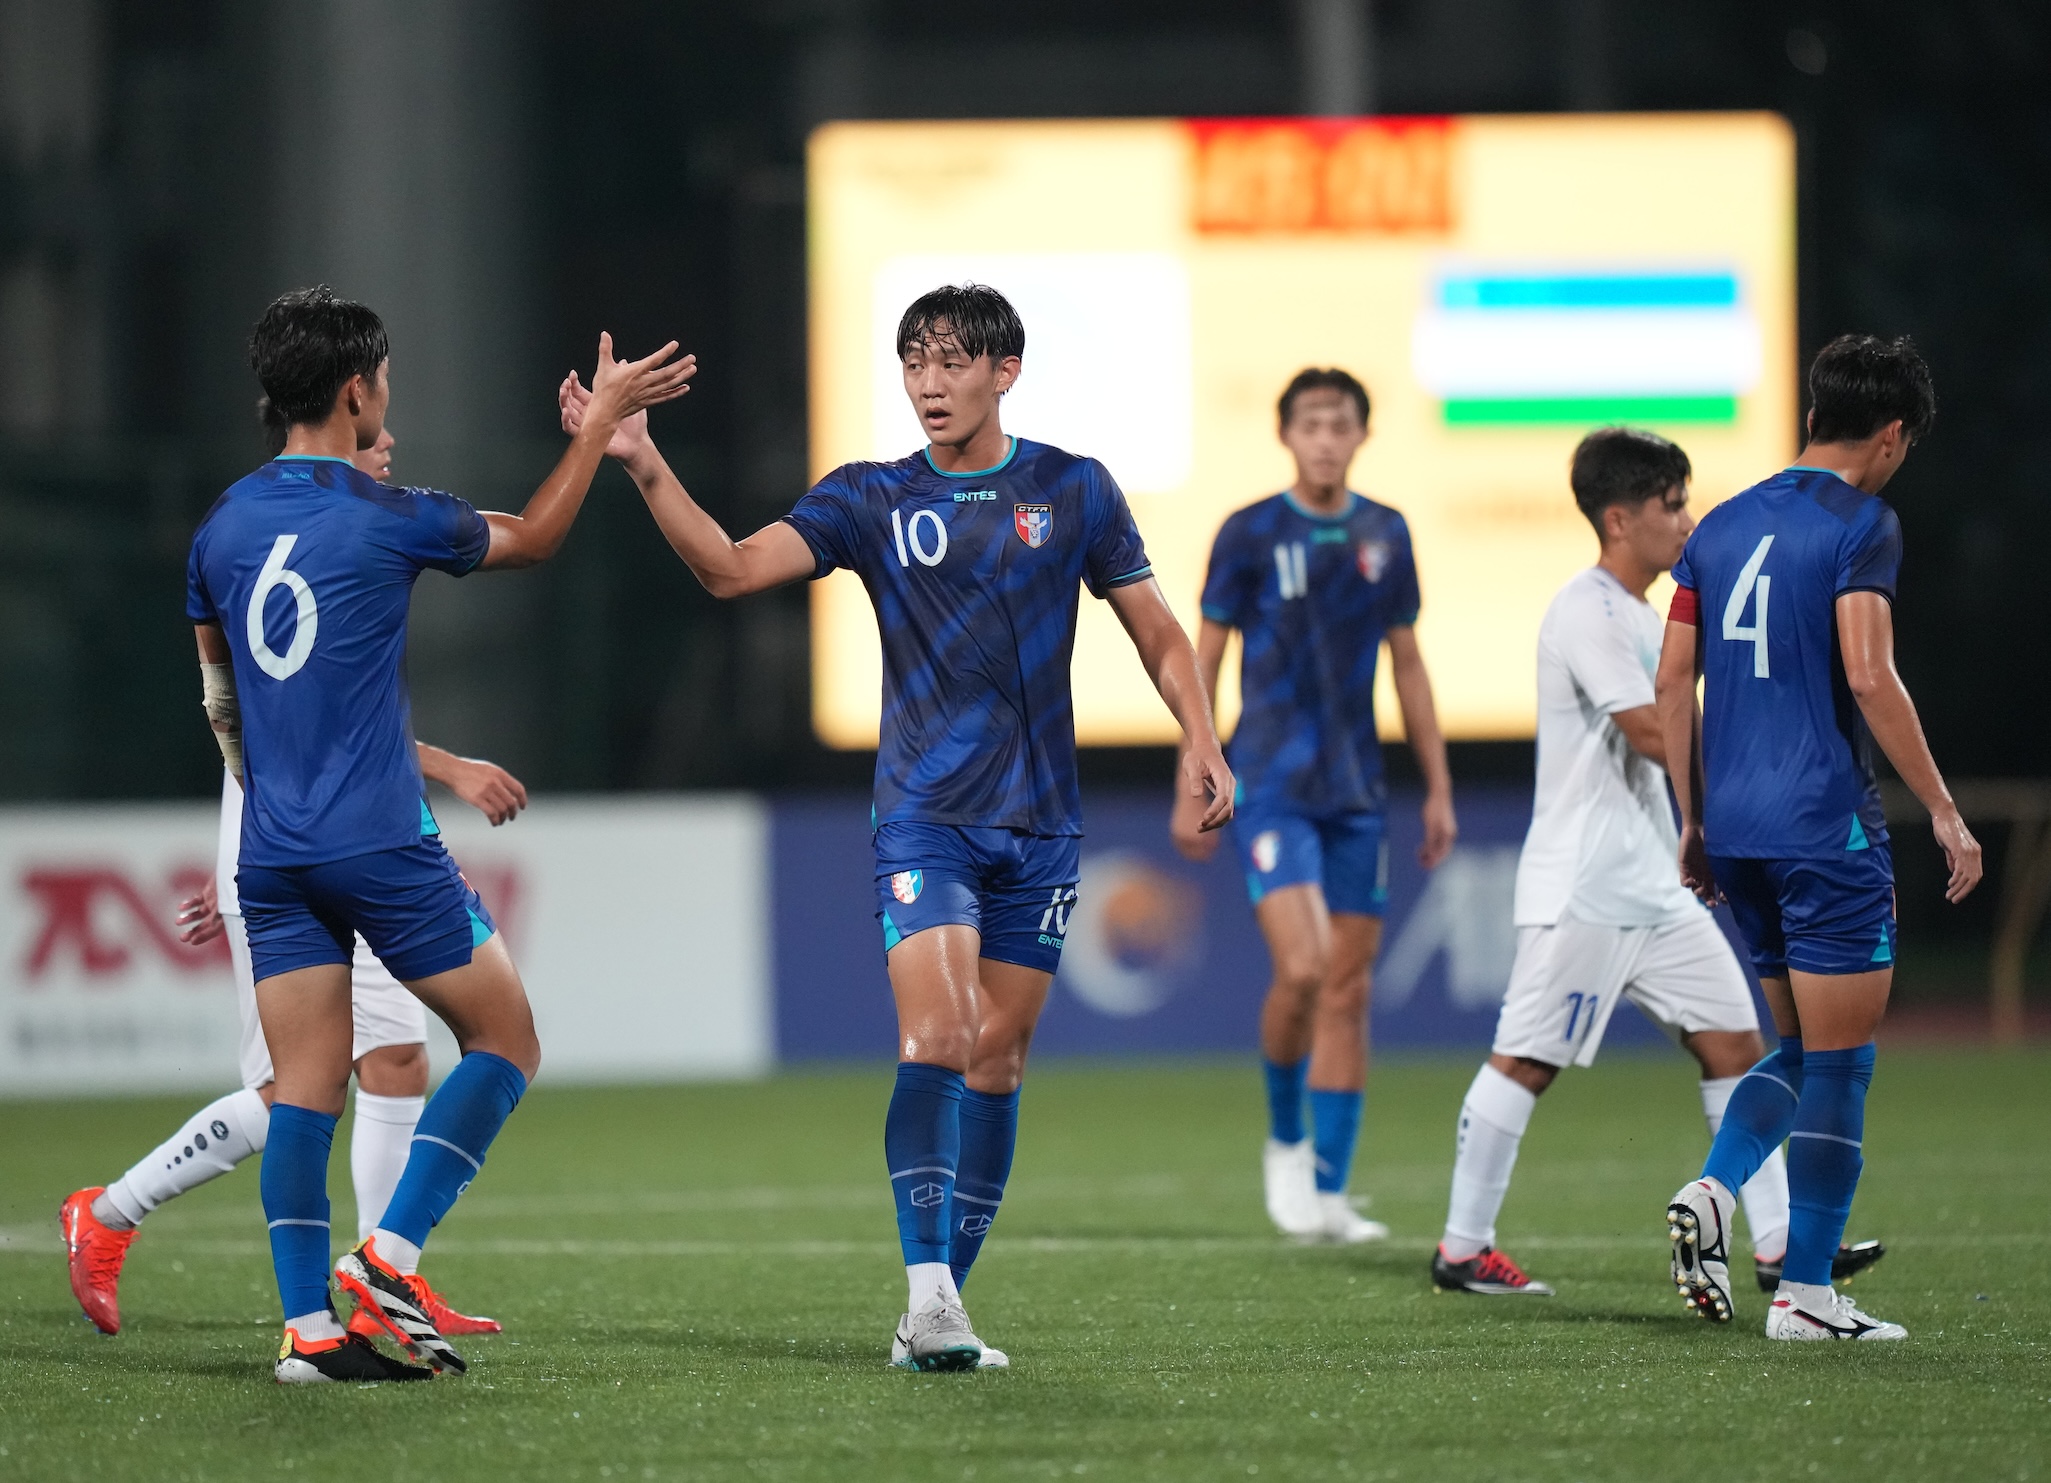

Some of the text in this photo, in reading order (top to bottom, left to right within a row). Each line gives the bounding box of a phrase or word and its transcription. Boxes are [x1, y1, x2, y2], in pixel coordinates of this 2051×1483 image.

[953, 490, 997, 502] ENTES
[890, 508, 948, 568] 10
[1274, 541, 1308, 599] 11
[246, 534, 318, 682] 6
[1722, 534, 1776, 679] 4
[1038, 934, 1064, 949] ENTE
[1565, 991, 1598, 1041] 11
